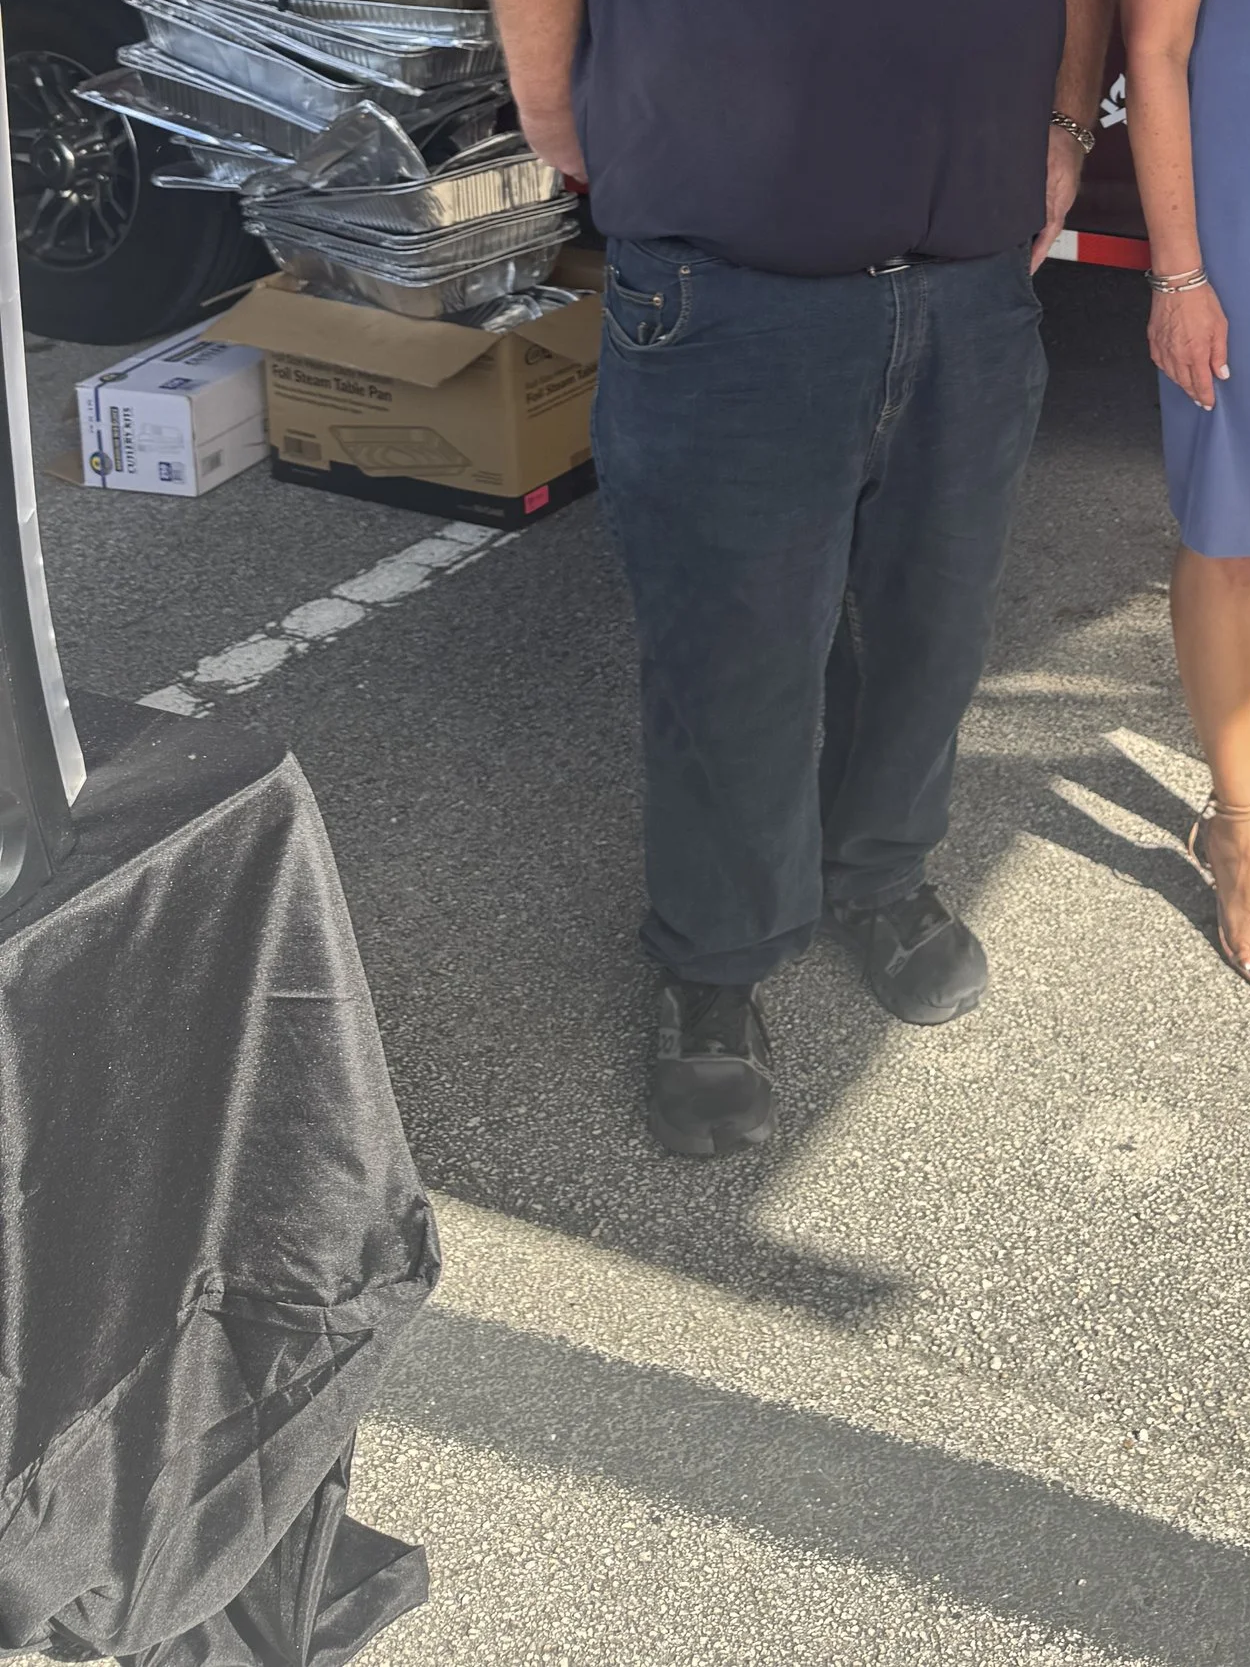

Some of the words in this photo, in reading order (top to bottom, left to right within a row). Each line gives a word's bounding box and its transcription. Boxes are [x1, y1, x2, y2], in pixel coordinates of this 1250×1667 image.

[272, 364, 292, 380] Foil
[293, 370, 333, 390] Steam
[333, 377, 366, 397] Table
[368, 385, 393, 402] Pan
